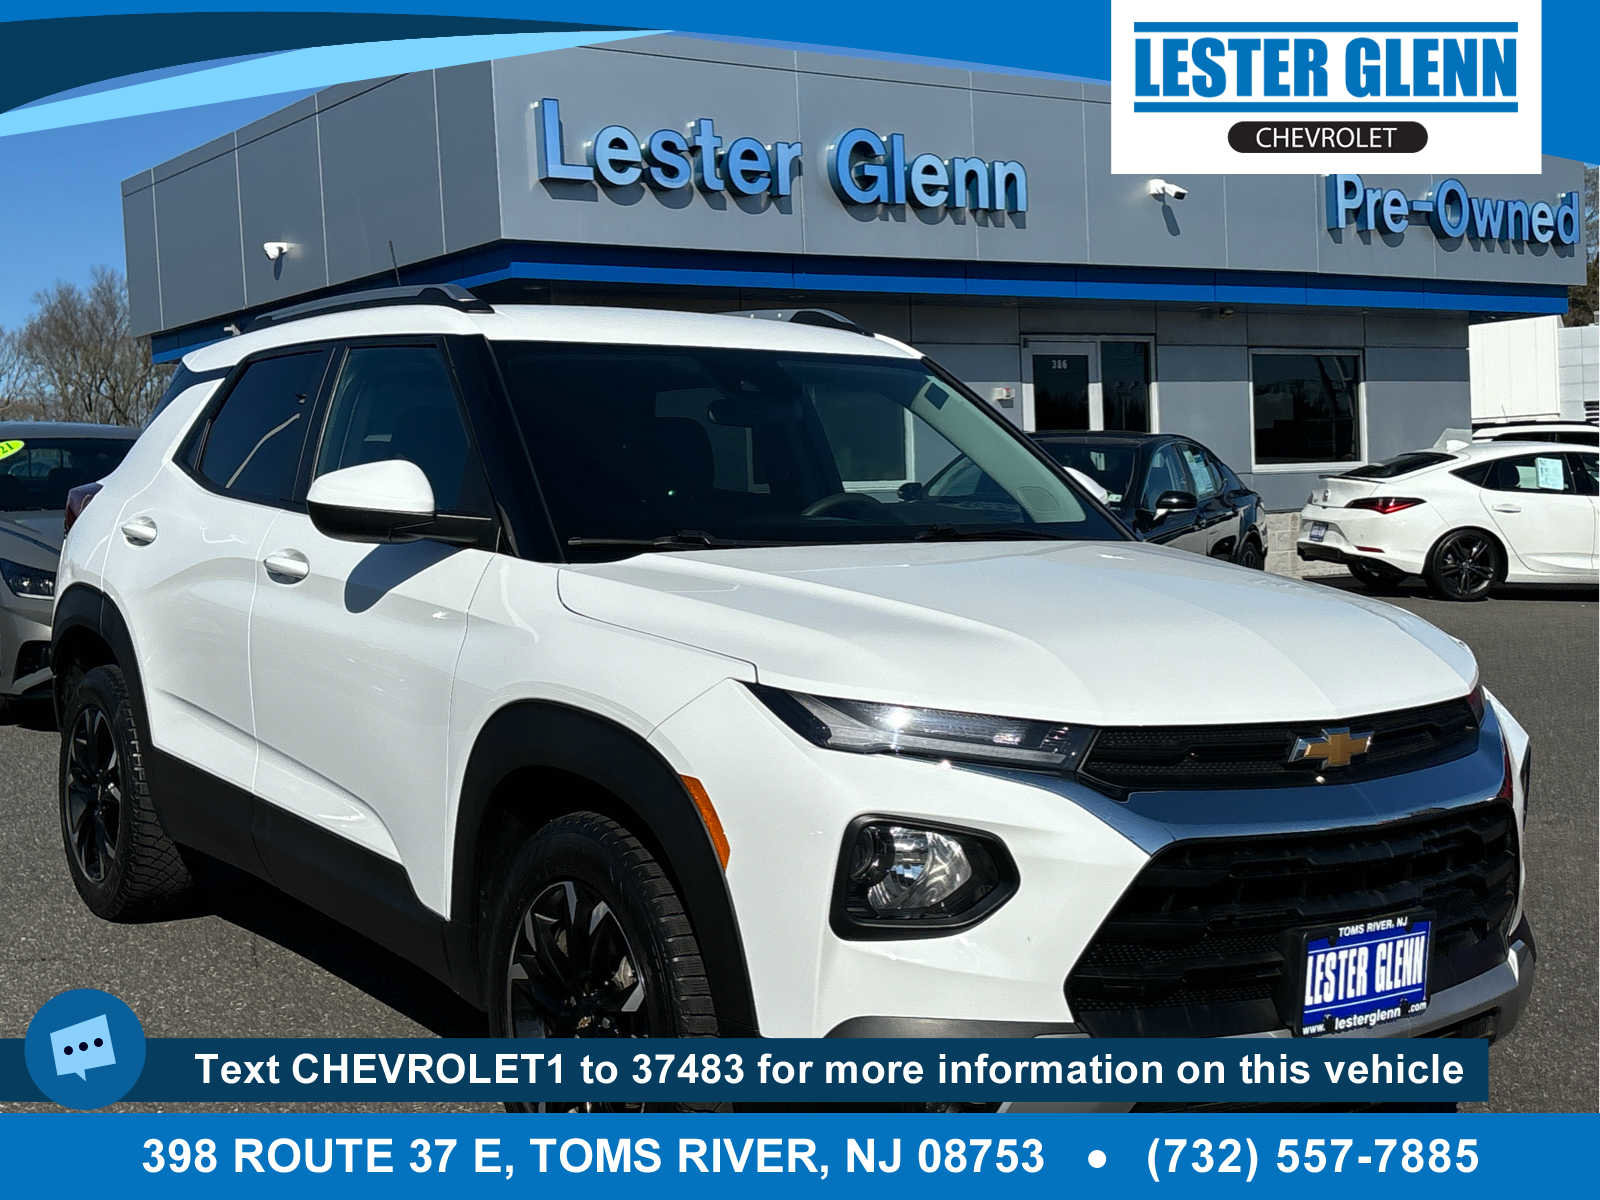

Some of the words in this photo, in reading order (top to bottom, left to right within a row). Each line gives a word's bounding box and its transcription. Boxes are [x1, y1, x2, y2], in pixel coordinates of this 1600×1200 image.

[536, 98, 803, 197] Lester
[828, 127, 1028, 212] Glenn
[1327, 174, 1581, 245] Pre-Owned
[1338, 924, 1364, 938] TOMS
[1396, 916, 1408, 928] NJ
[1304, 946, 1369, 1006] LESTER
[1375, 935, 1426, 993] GLENN
